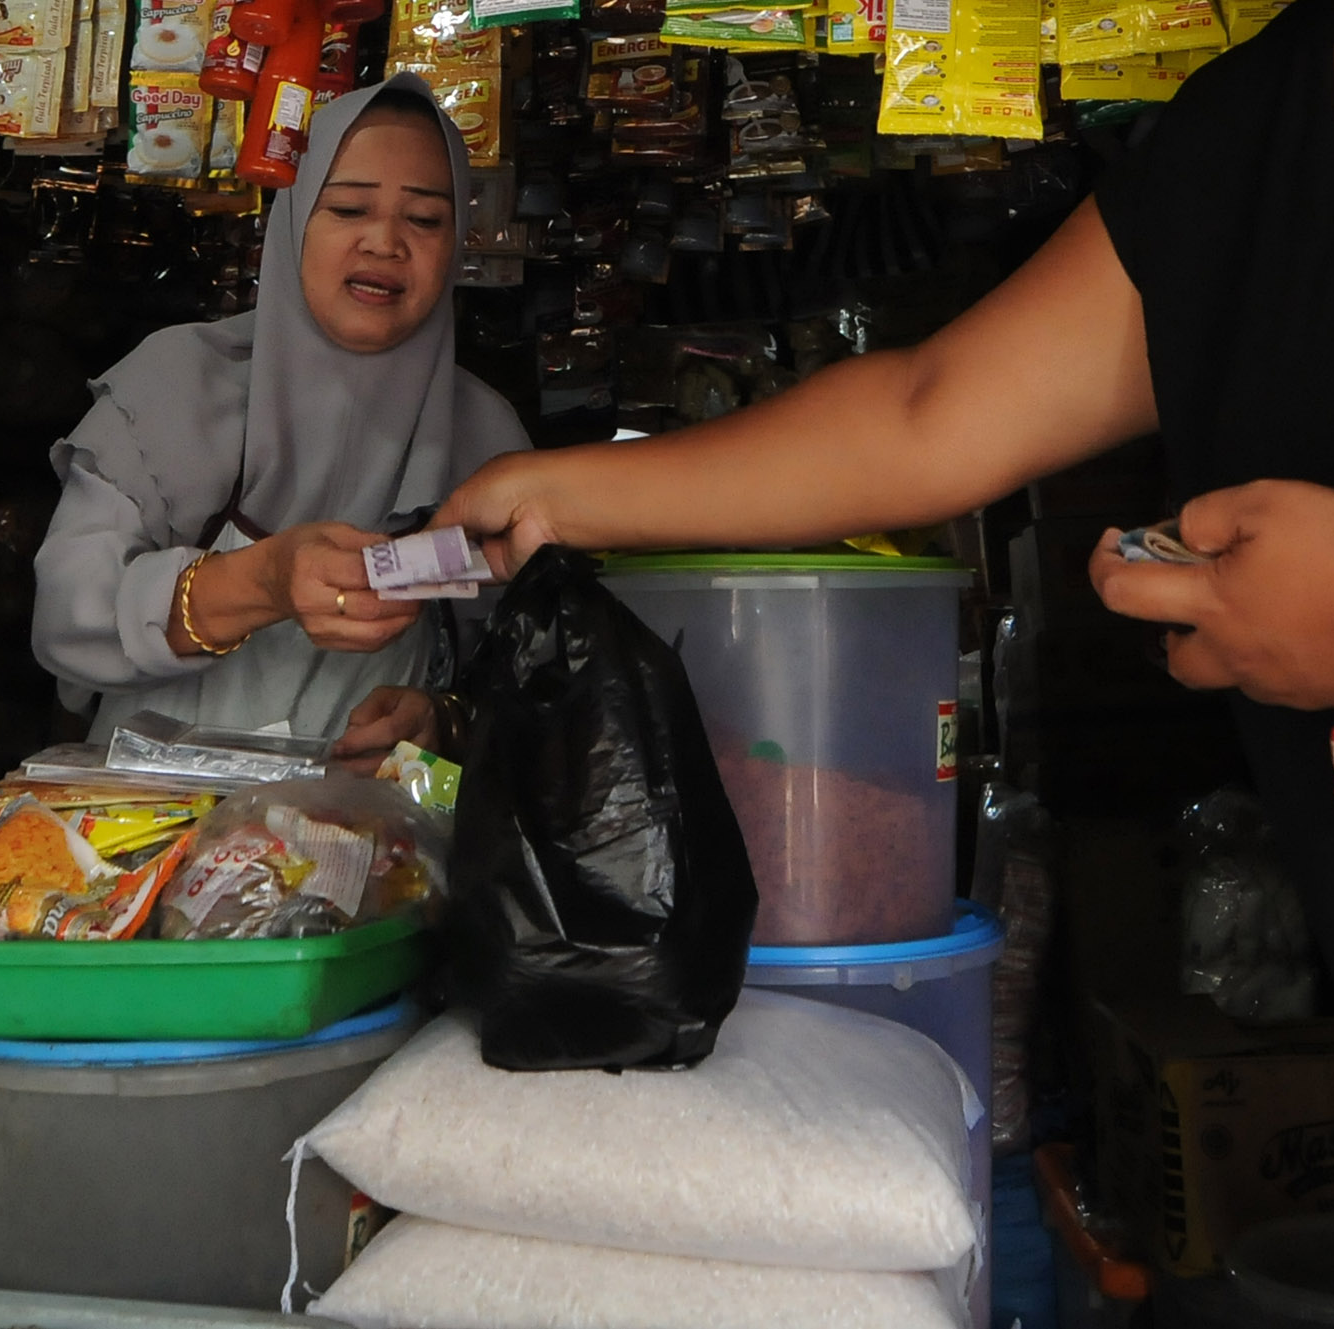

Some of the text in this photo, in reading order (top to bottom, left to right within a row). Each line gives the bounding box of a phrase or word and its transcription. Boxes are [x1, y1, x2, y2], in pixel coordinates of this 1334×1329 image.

[140, 3, 197, 20] Cappuccino
[36, 58, 53, 124] Gula Terpisah
[131, 89, 202, 110] Good Day
[135, 108, 192, 125] Cappuccino
